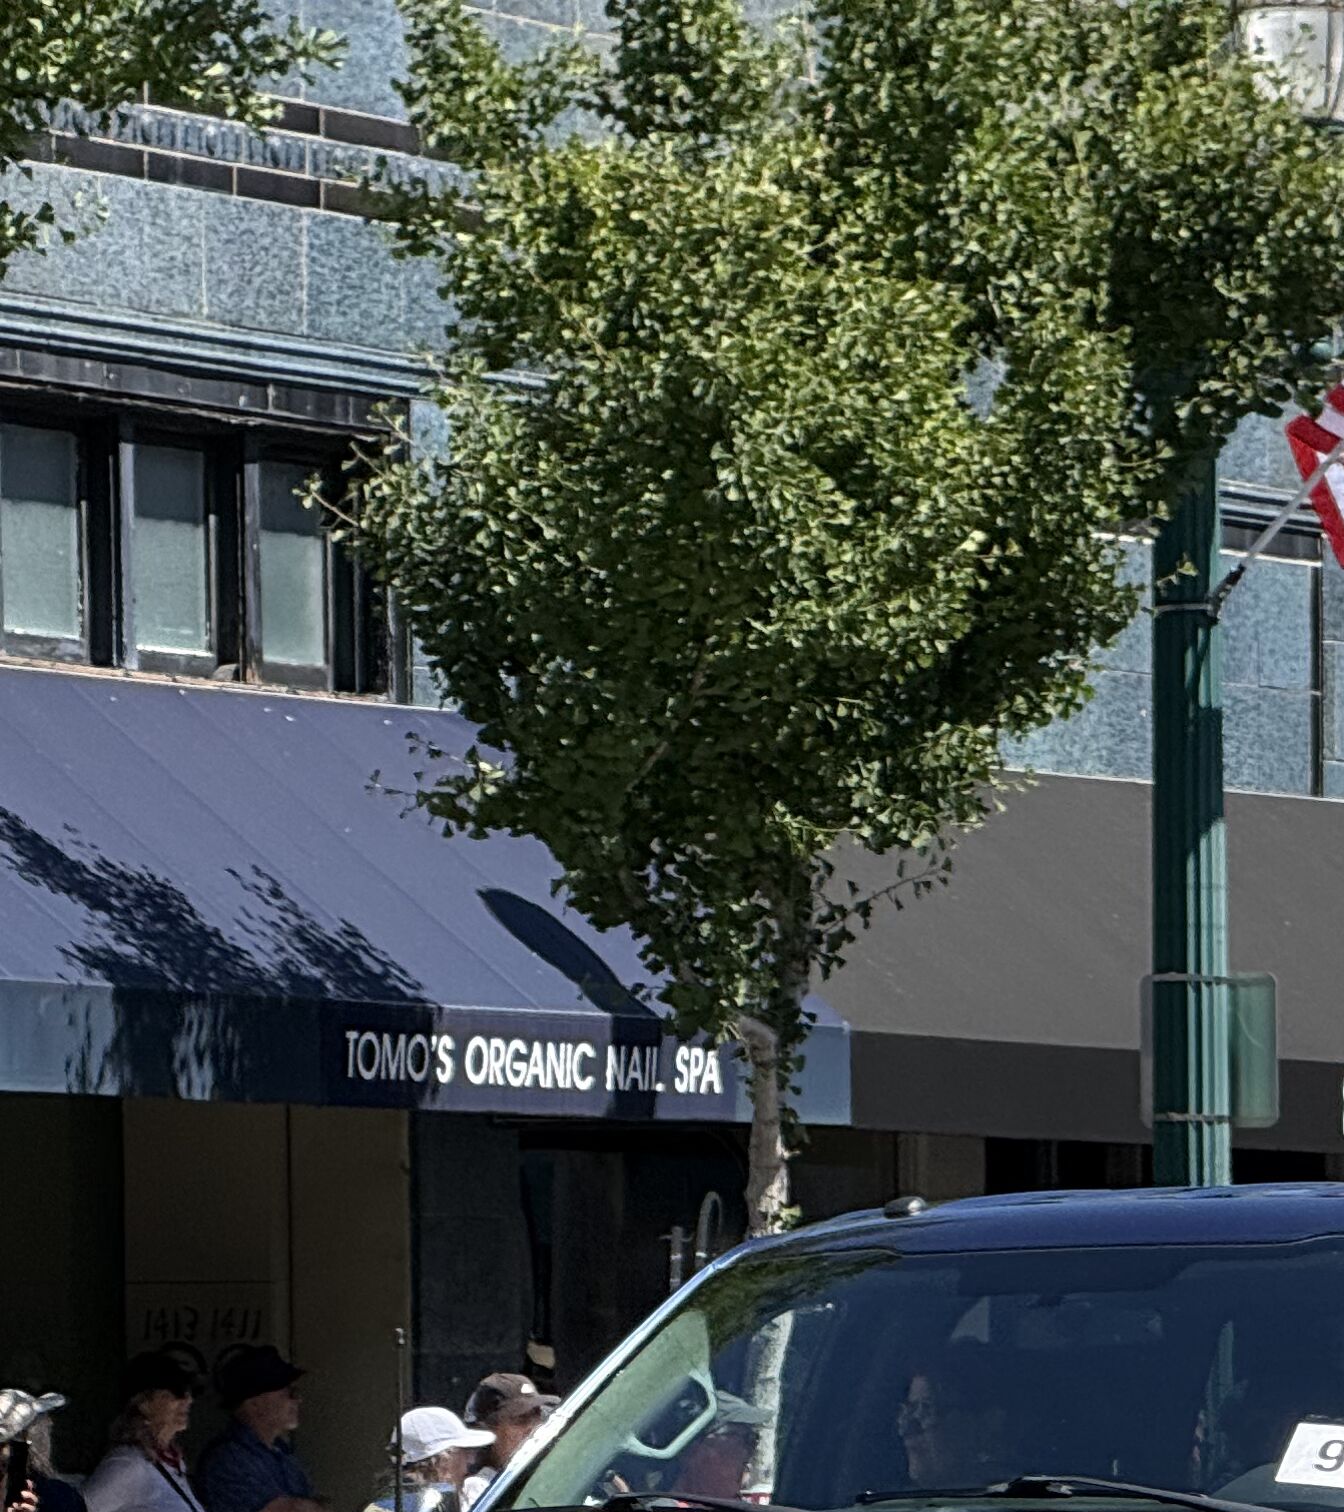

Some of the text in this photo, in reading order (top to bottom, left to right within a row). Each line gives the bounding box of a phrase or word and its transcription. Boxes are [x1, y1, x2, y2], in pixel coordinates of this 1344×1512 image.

[345, 1031, 723, 1094] TOMO'S ORGANIC NAIL SPA
